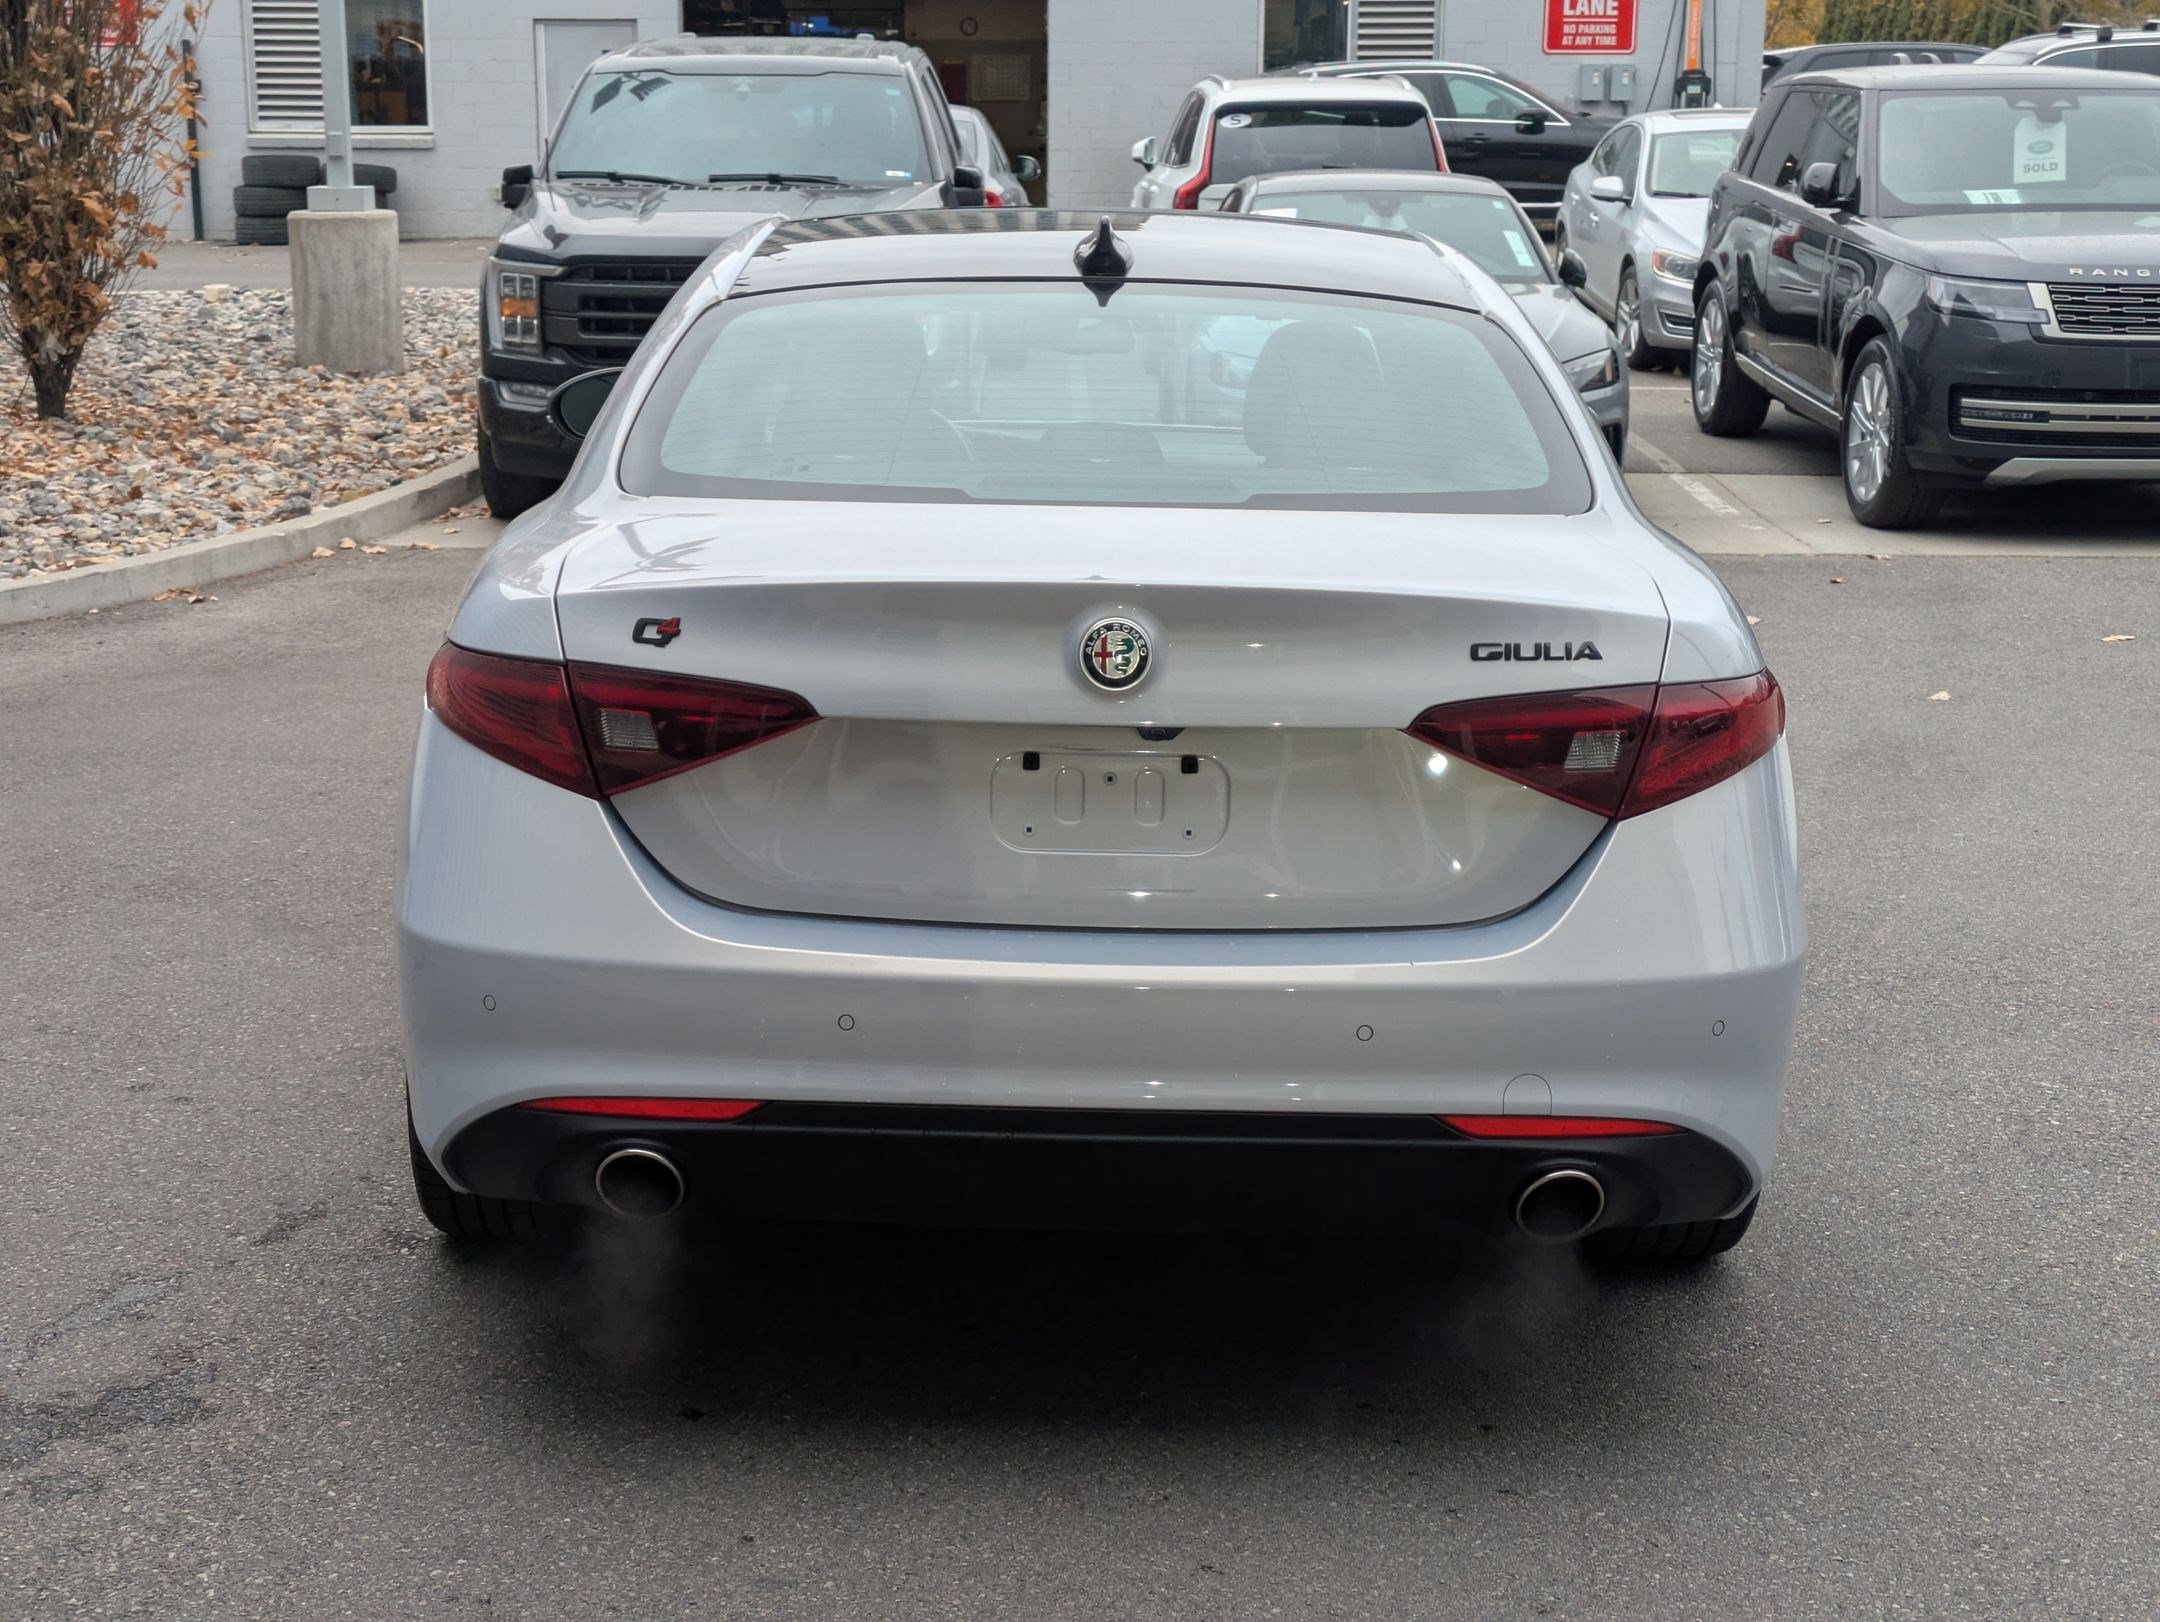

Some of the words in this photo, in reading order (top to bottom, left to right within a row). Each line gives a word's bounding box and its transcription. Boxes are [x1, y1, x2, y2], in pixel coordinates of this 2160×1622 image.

[1563, 0, 1619, 16] LANE
[1563, 24, 1577, 34] NO
[1578, 24, 1617, 34] PARKING
[1562, 35, 1574, 46] AT
[1575, 35, 1593, 46] ANY
[1594, 35, 1617, 46] TIME
[1230, 114, 1242, 126] S
[2023, 162, 2059, 174] SOLD
[2069, 267, 2160, 277] RANG
[1085, 627, 1107, 655] ALFA
[1113, 623, 1147, 656] ROMEO
[1470, 641, 1604, 662] GIULIA
